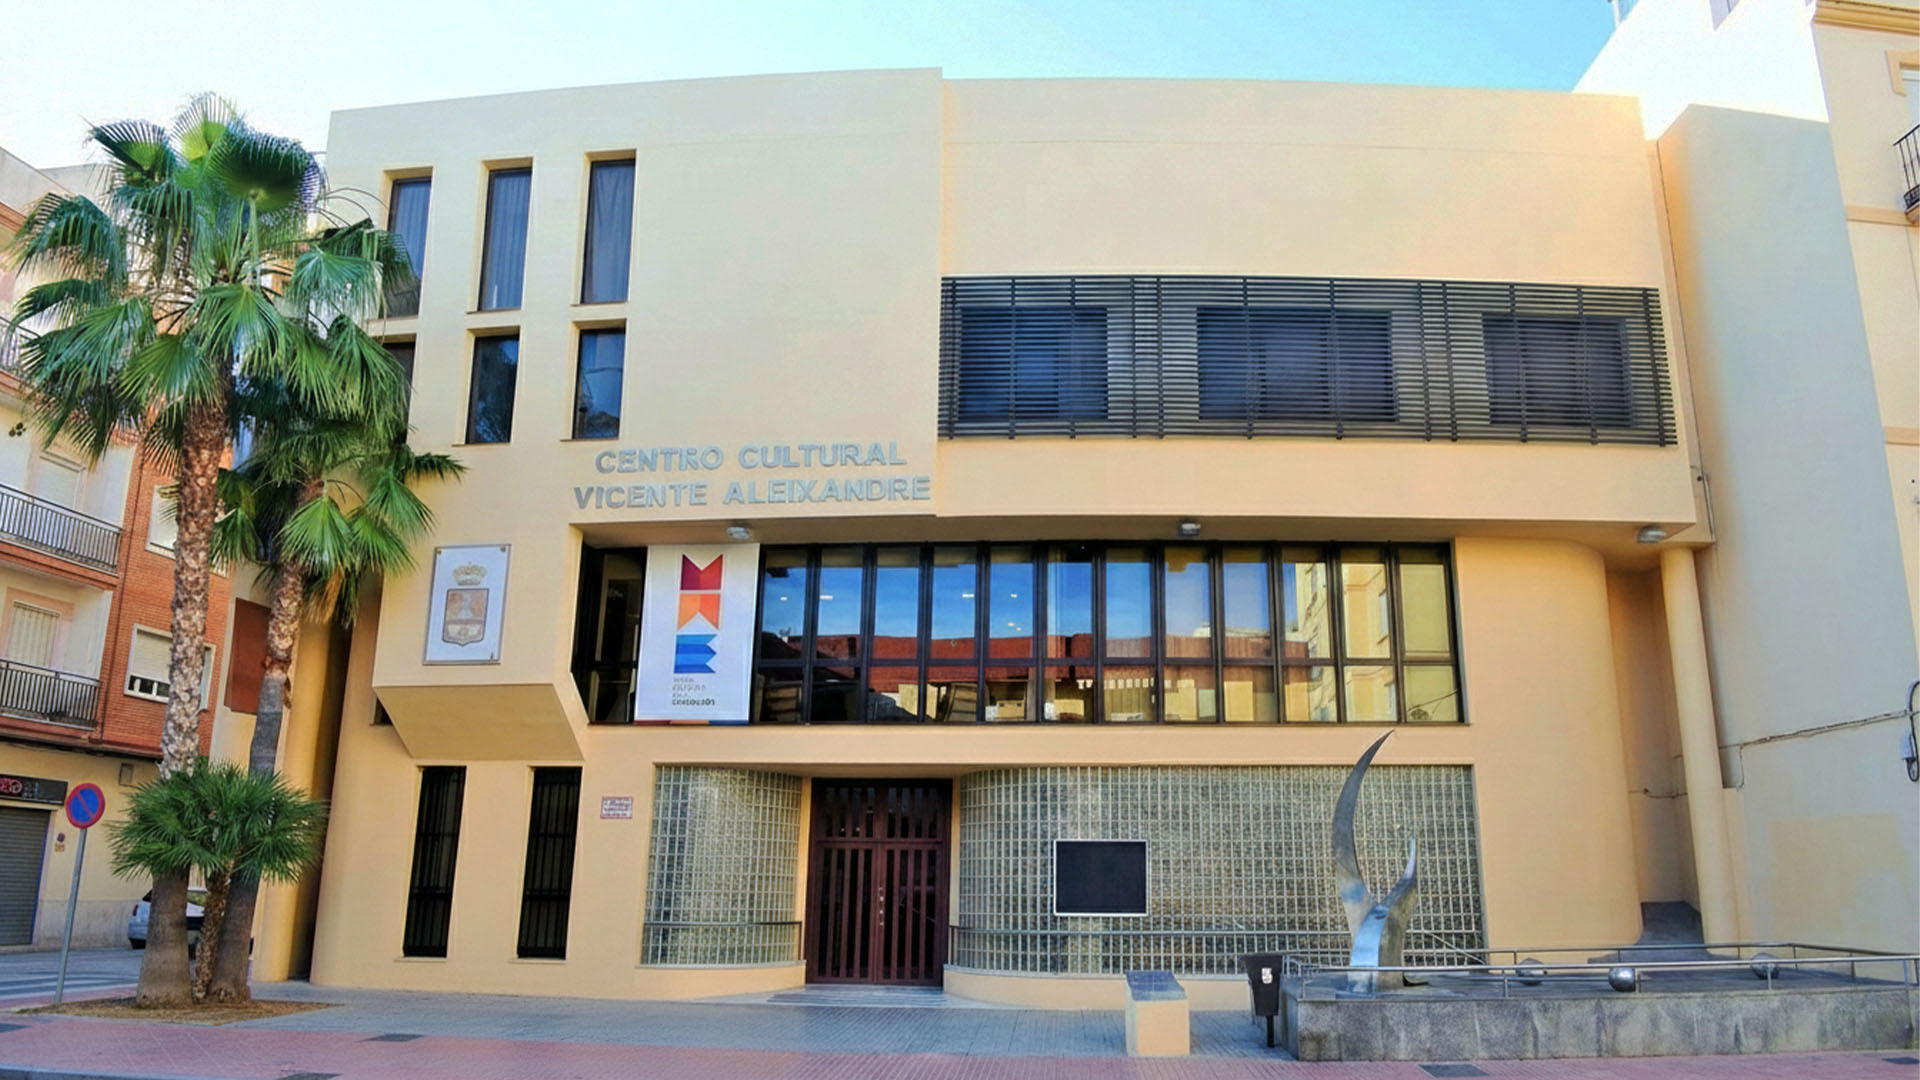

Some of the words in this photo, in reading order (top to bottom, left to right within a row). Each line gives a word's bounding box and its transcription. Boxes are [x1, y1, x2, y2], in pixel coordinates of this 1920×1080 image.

[596, 445, 724, 473] CENTRO
[738, 441, 907, 469] CULTURAL
[574, 484, 708, 509] VICENTE
[722, 476, 932, 505] ALEIXANDRE
